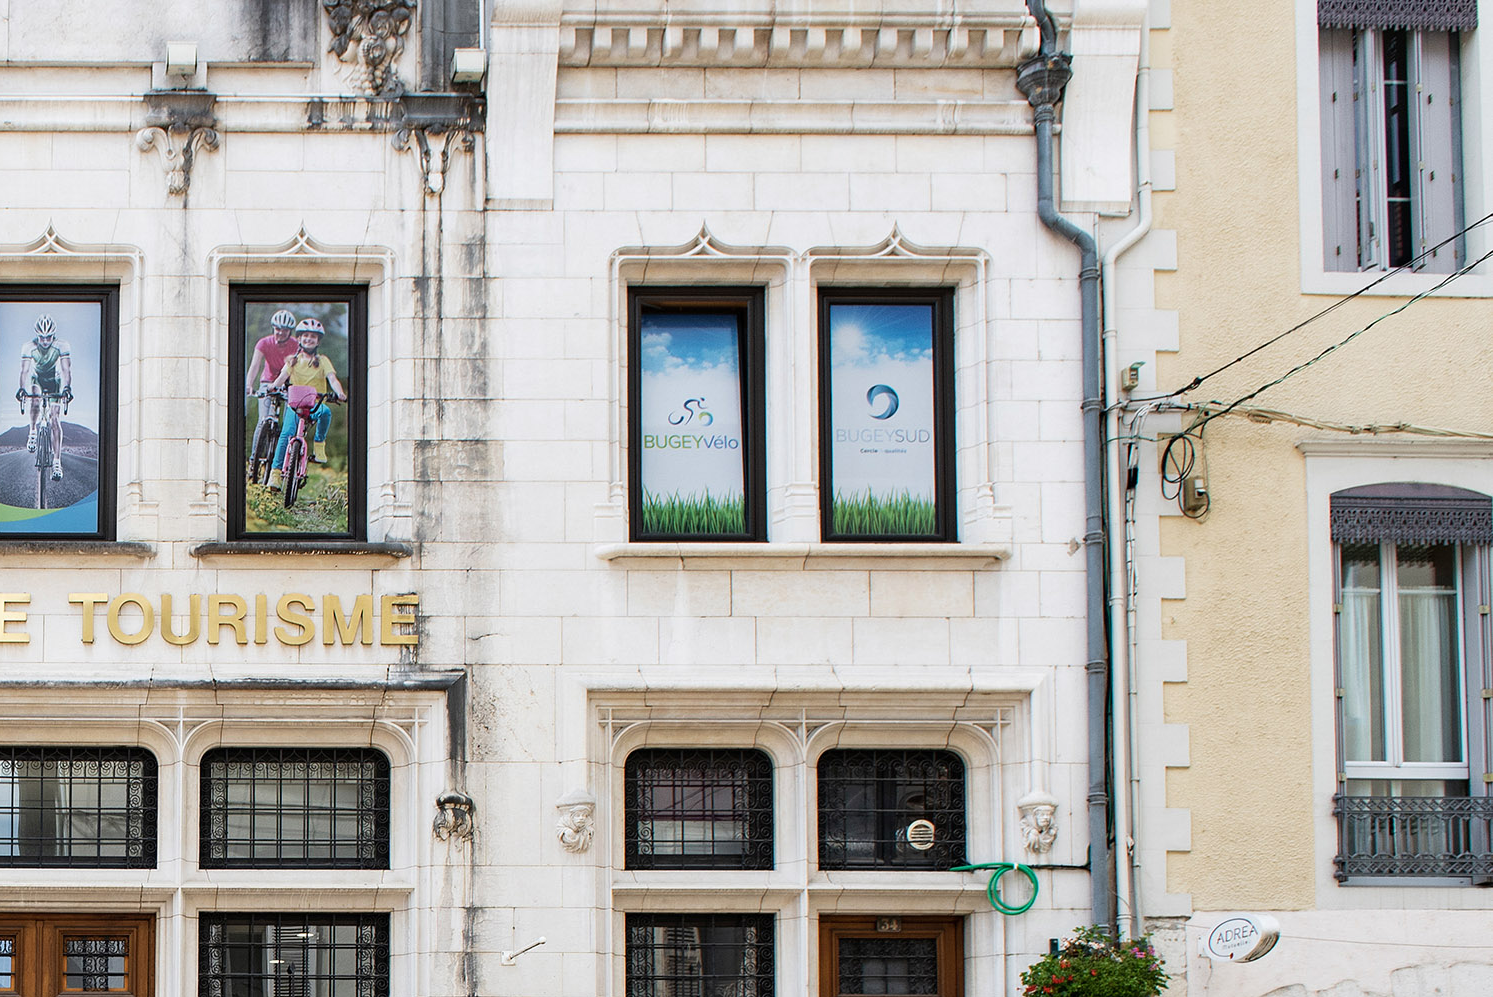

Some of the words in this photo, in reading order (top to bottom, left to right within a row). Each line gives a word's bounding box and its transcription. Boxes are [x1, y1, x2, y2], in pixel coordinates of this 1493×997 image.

[643, 433, 739, 450] BUGEYVélo
[835, 428, 931, 443] BUGEYSUD
[68, 592, 420, 647] TOURISME
[1216, 924, 1259, 944] ADREA
